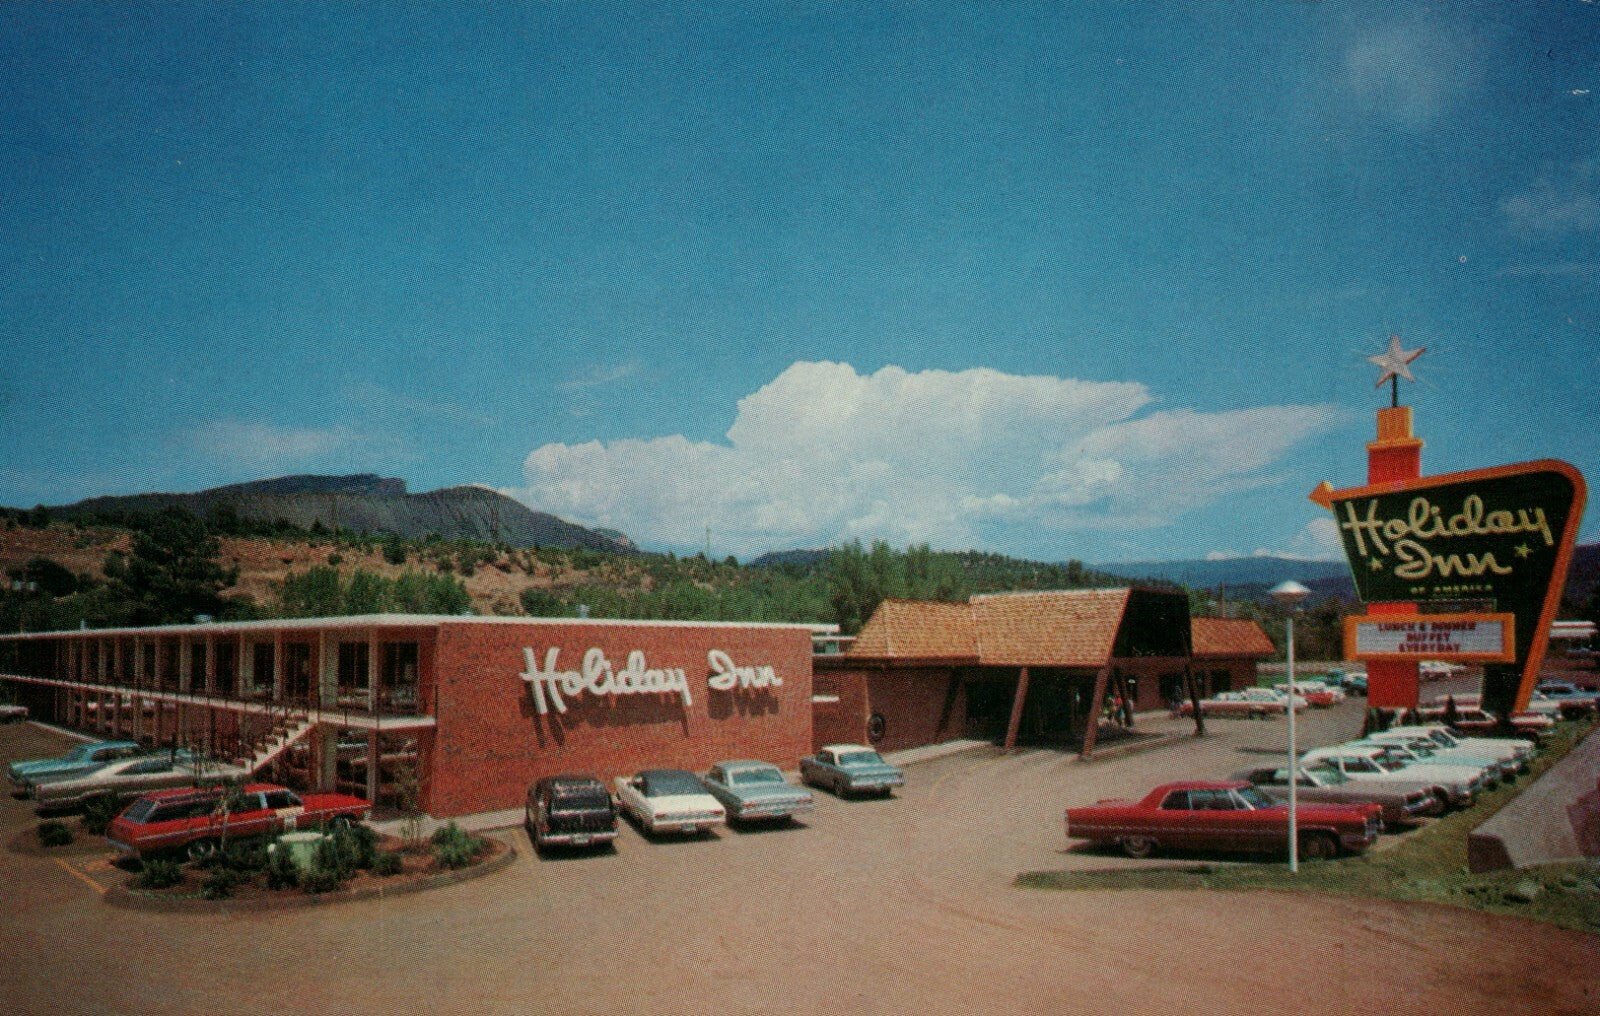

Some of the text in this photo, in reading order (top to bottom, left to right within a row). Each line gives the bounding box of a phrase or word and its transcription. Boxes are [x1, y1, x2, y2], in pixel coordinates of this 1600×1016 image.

[1342, 494, 1555, 556] Holiday
[1394, 539, 1513, 579] Inn
[1433, 583, 1493, 593] AMERICA
[1406, 632, 1451, 642] BUFFET
[518, 646, 783, 714] Holiday Inn
